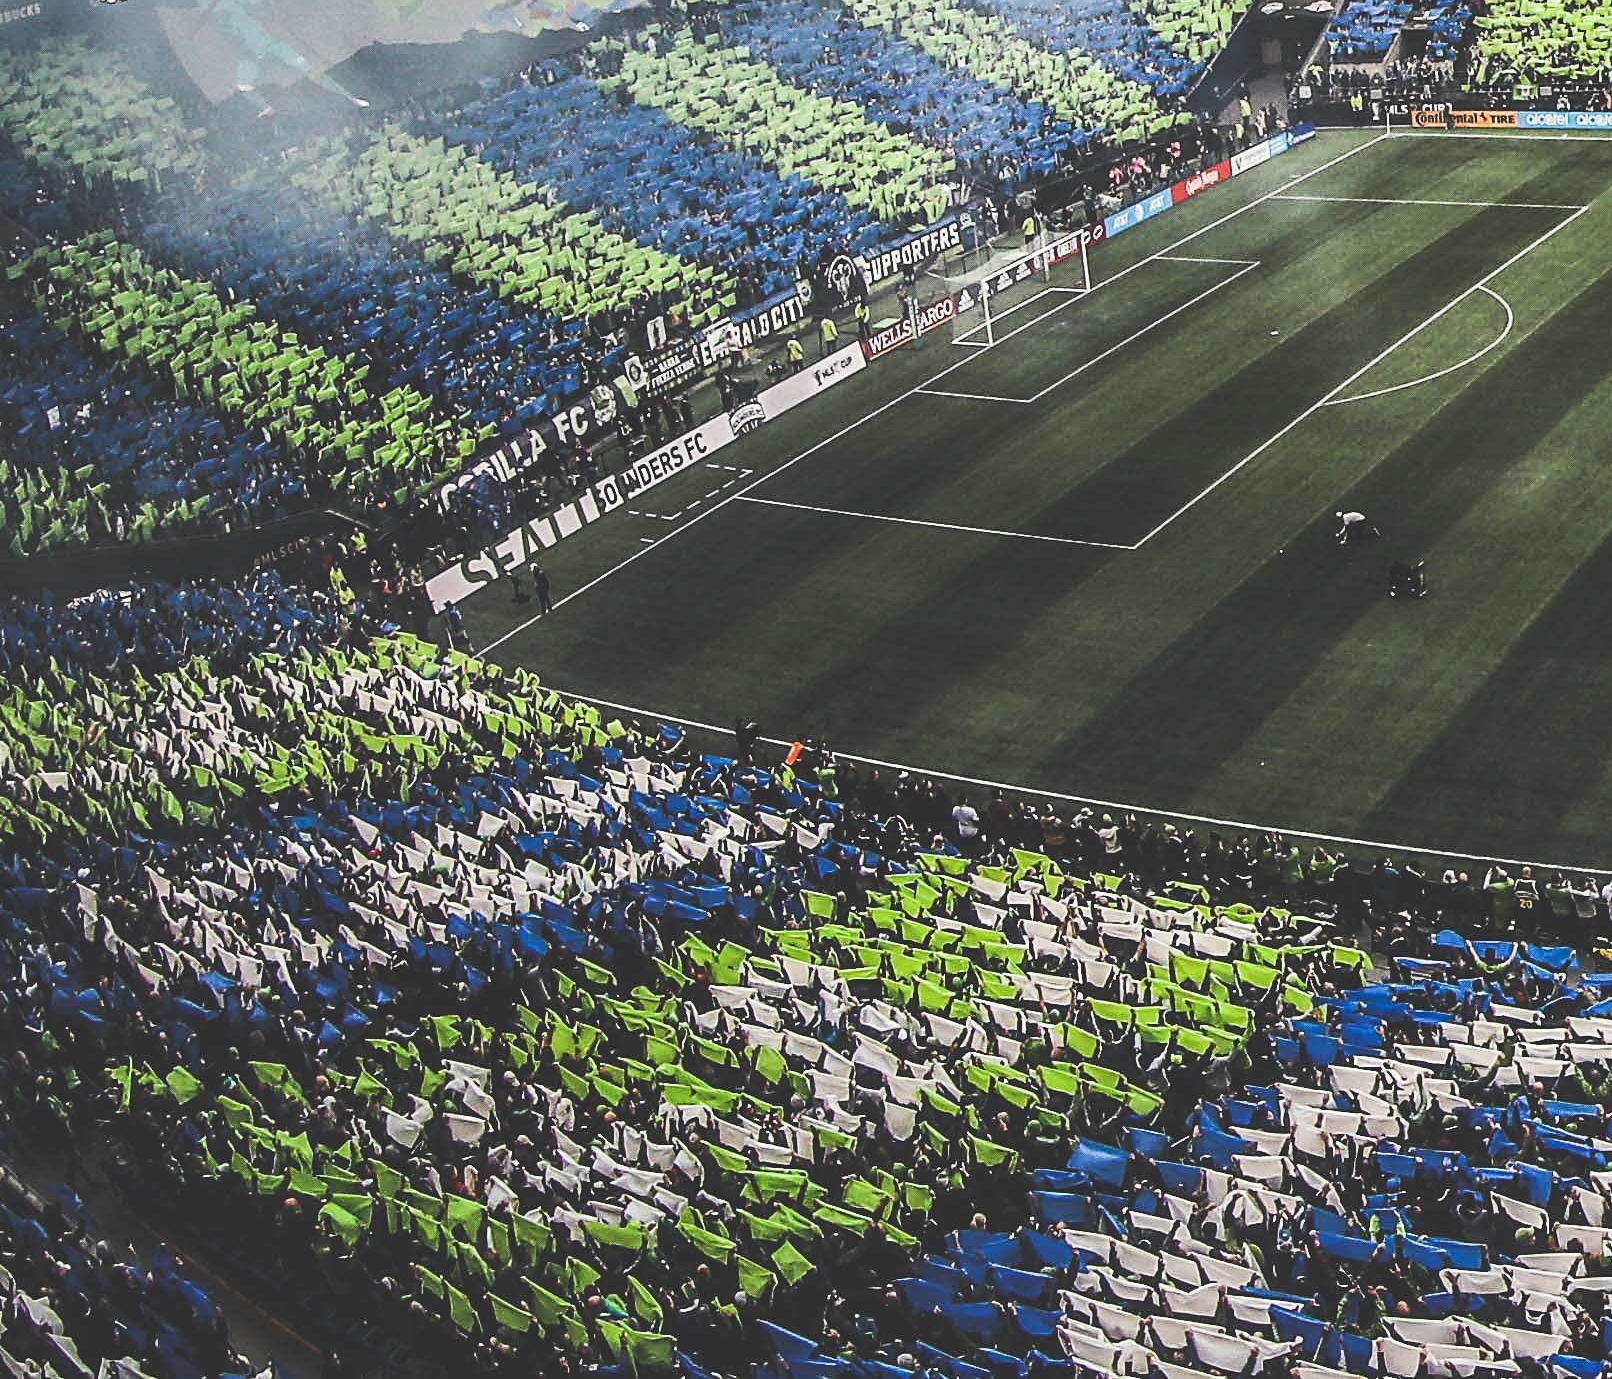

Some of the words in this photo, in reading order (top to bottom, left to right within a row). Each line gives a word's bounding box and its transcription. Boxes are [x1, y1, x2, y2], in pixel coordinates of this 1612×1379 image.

[1416, 112, 1478, 125] Contiental
[1491, 114, 1515, 124] TIRE
[869, 324, 912, 354] WELLS
[552, 405, 589, 444] FC
[688, 432, 708, 460] FC
